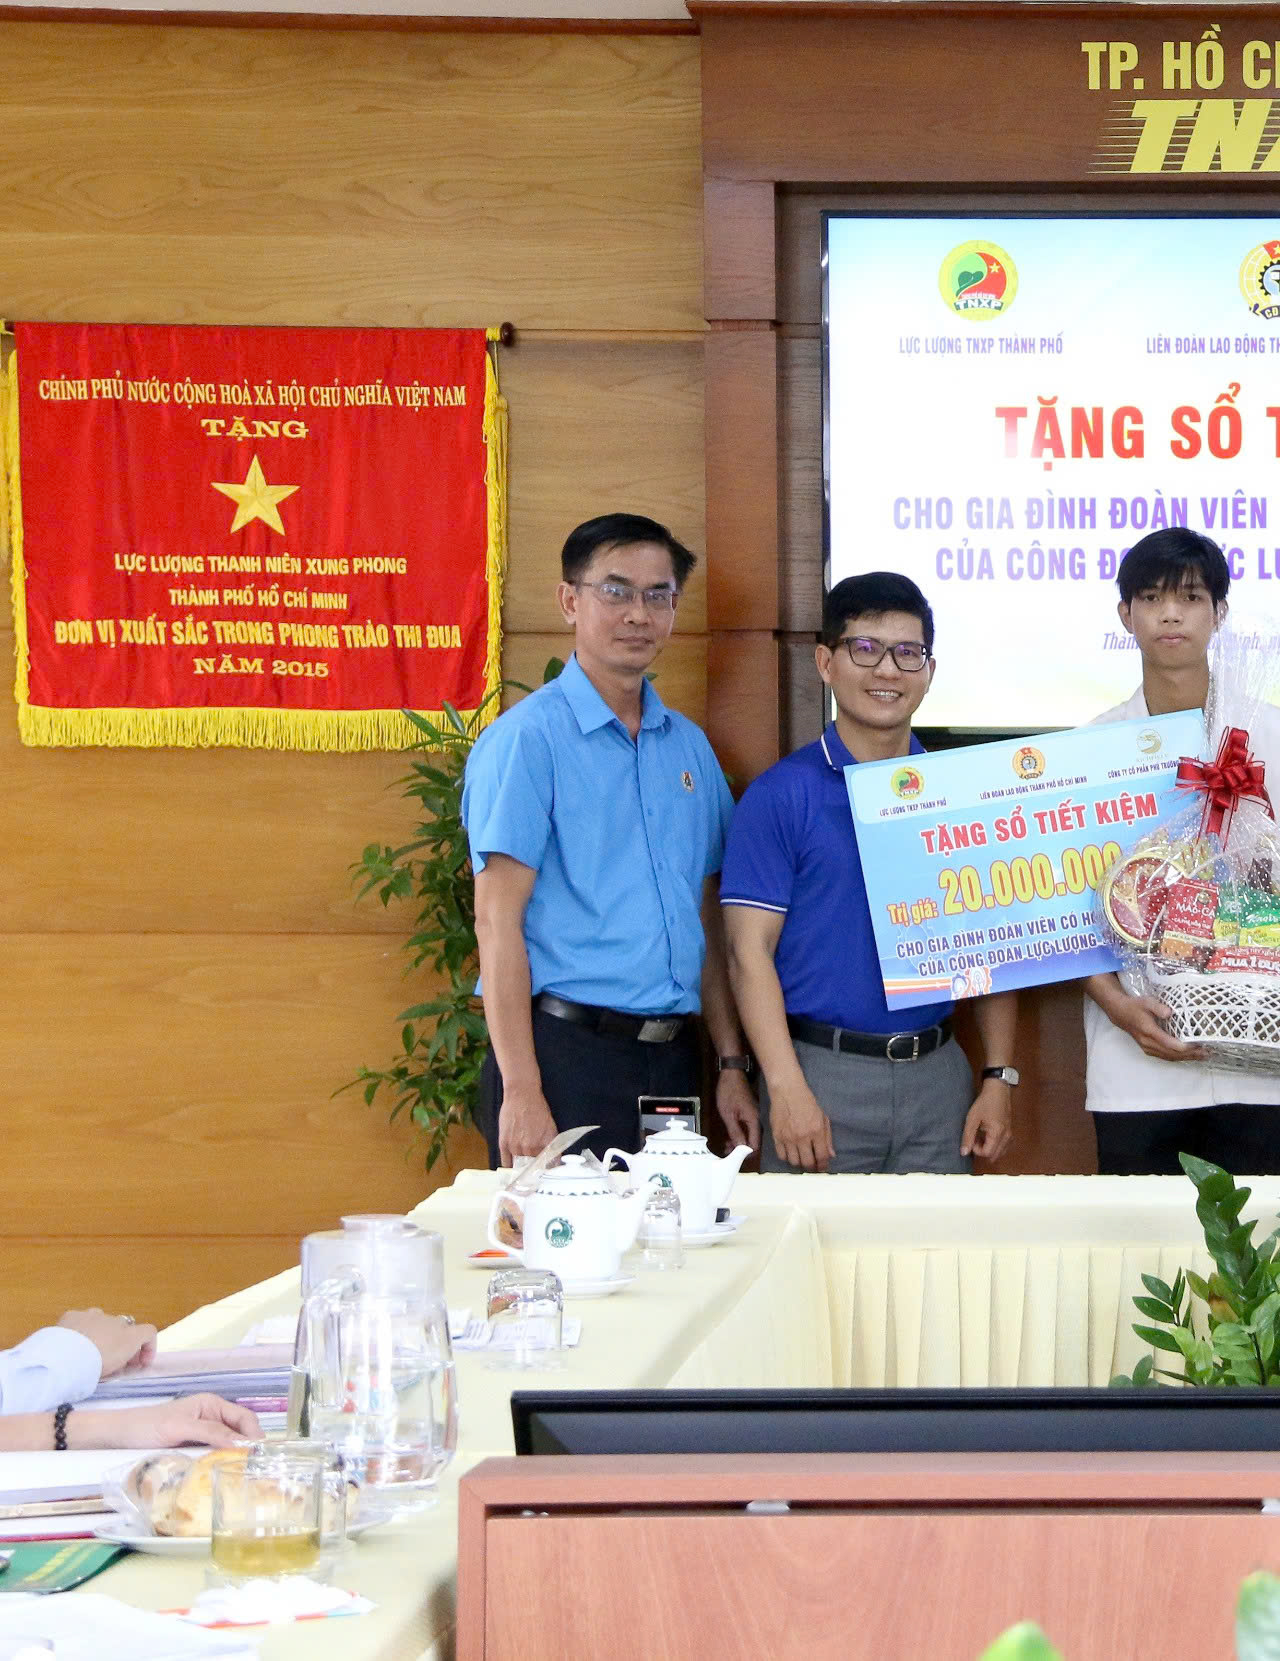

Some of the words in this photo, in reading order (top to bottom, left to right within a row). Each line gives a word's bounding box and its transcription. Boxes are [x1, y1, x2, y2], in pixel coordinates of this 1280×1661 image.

[1081, 41, 1145, 90] TP.
[1162, 23, 1225, 90] HỒ
[955, 298, 1002, 310] TNXP
[925, 335, 962, 358] LƯỢNG
[966, 337, 994, 354] TNXP
[998, 331, 1036, 354] THÀNH
[1039, 331, 1064, 354] PHỐ
[1146, 333, 1171, 354] LIÊN
[1175, 333, 1205, 354] ĐOÀN
[1209, 336, 1231, 354] LAO
[1234, 332, 1266, 358] ĐỘNG
[39, 374, 88, 400] CHÍNH
[91, 369, 123, 400] PHỦ
[127, 376, 170, 403] NƯỚC
[173, 376, 217, 410] CỘNG
[254, 379, 276, 406] XÃ
[278, 379, 306, 412] HỘI
[309, 377, 341, 407] CHỦ
[344, 379, 393, 407] NGHĨA
[395, 380, 430, 412] VIỆT
[433, 385, 467, 407] NAM
[200, 415, 309, 441] TẶNG
[995, 395, 1145, 471] TẶNG
[1170, 381, 1243, 460] SỔ
[893, 496, 954, 530] CHO
[966, 496, 1014, 530] GIA
[1025, 489, 1097, 530] ĐÌNH
[1108, 488, 1188, 530] ĐOÀN
[1200, 488, 1267, 530] VIÊN
[114, 552, 147, 576] LỰC
[150, 553, 205, 578] LƯỢNG
[207, 555, 262, 573] THANH
[265, 552, 302, 574] NIÊN
[305, 557, 350, 576] XUNG
[353, 556, 408, 575] PHONG
[935, 538, 995, 581] CỦA
[1006, 539, 1086, 581] CÔNG
[168, 584, 220, 606] THÀNH
[223, 583, 255, 606] PHỐ
[257, 582, 280, 607] HỒ
[283, 587, 308, 609] CHÍ
[311, 591, 348, 610] MINH
[54, 618, 94, 645] ĐƠN
[96, 619, 116, 649] VỊ
[119, 612, 167, 645] XUẤT
[171, 613, 209, 645] SẮC
[212, 620, 275, 646] TRONG
[278, 622, 340, 649] PHONG
[341, 619, 389, 649] TRÀO
[393, 624, 423, 649] THI
[426, 625, 462, 649] ĐUA
[1104, 630, 1139, 650] Thàn
[192, 653, 265, 675] NĂM
[271, 659, 329, 677] 2015
[920, 822, 988, 857] TẶNG
[995, 805, 1027, 842] SỔ
[1033, 799, 1086, 834] TIẾT
[1094, 792, 1158, 826] KIỆM
[887, 901, 910, 927] Trị
[911, 898, 939, 925] giá:
[896, 940, 924, 959] CHO
[927, 936, 950, 953] GIA
[953, 928, 985, 949] ĐÌNH
[988, 921, 1023, 943] ĐOÀN
[1026, 915, 1057, 936] VIÊN
[1060, 911, 1078, 931] CÓ
[918, 958, 945, 977] CỦA
[949, 952, 984, 972] CÔNG
[988, 945, 1023, 965] ĐOÀN
[1026, 940, 1052, 961] LỰC
[1054, 932, 1098, 955] LƯỢNG
[1220, 957, 1249, 967] MUA
